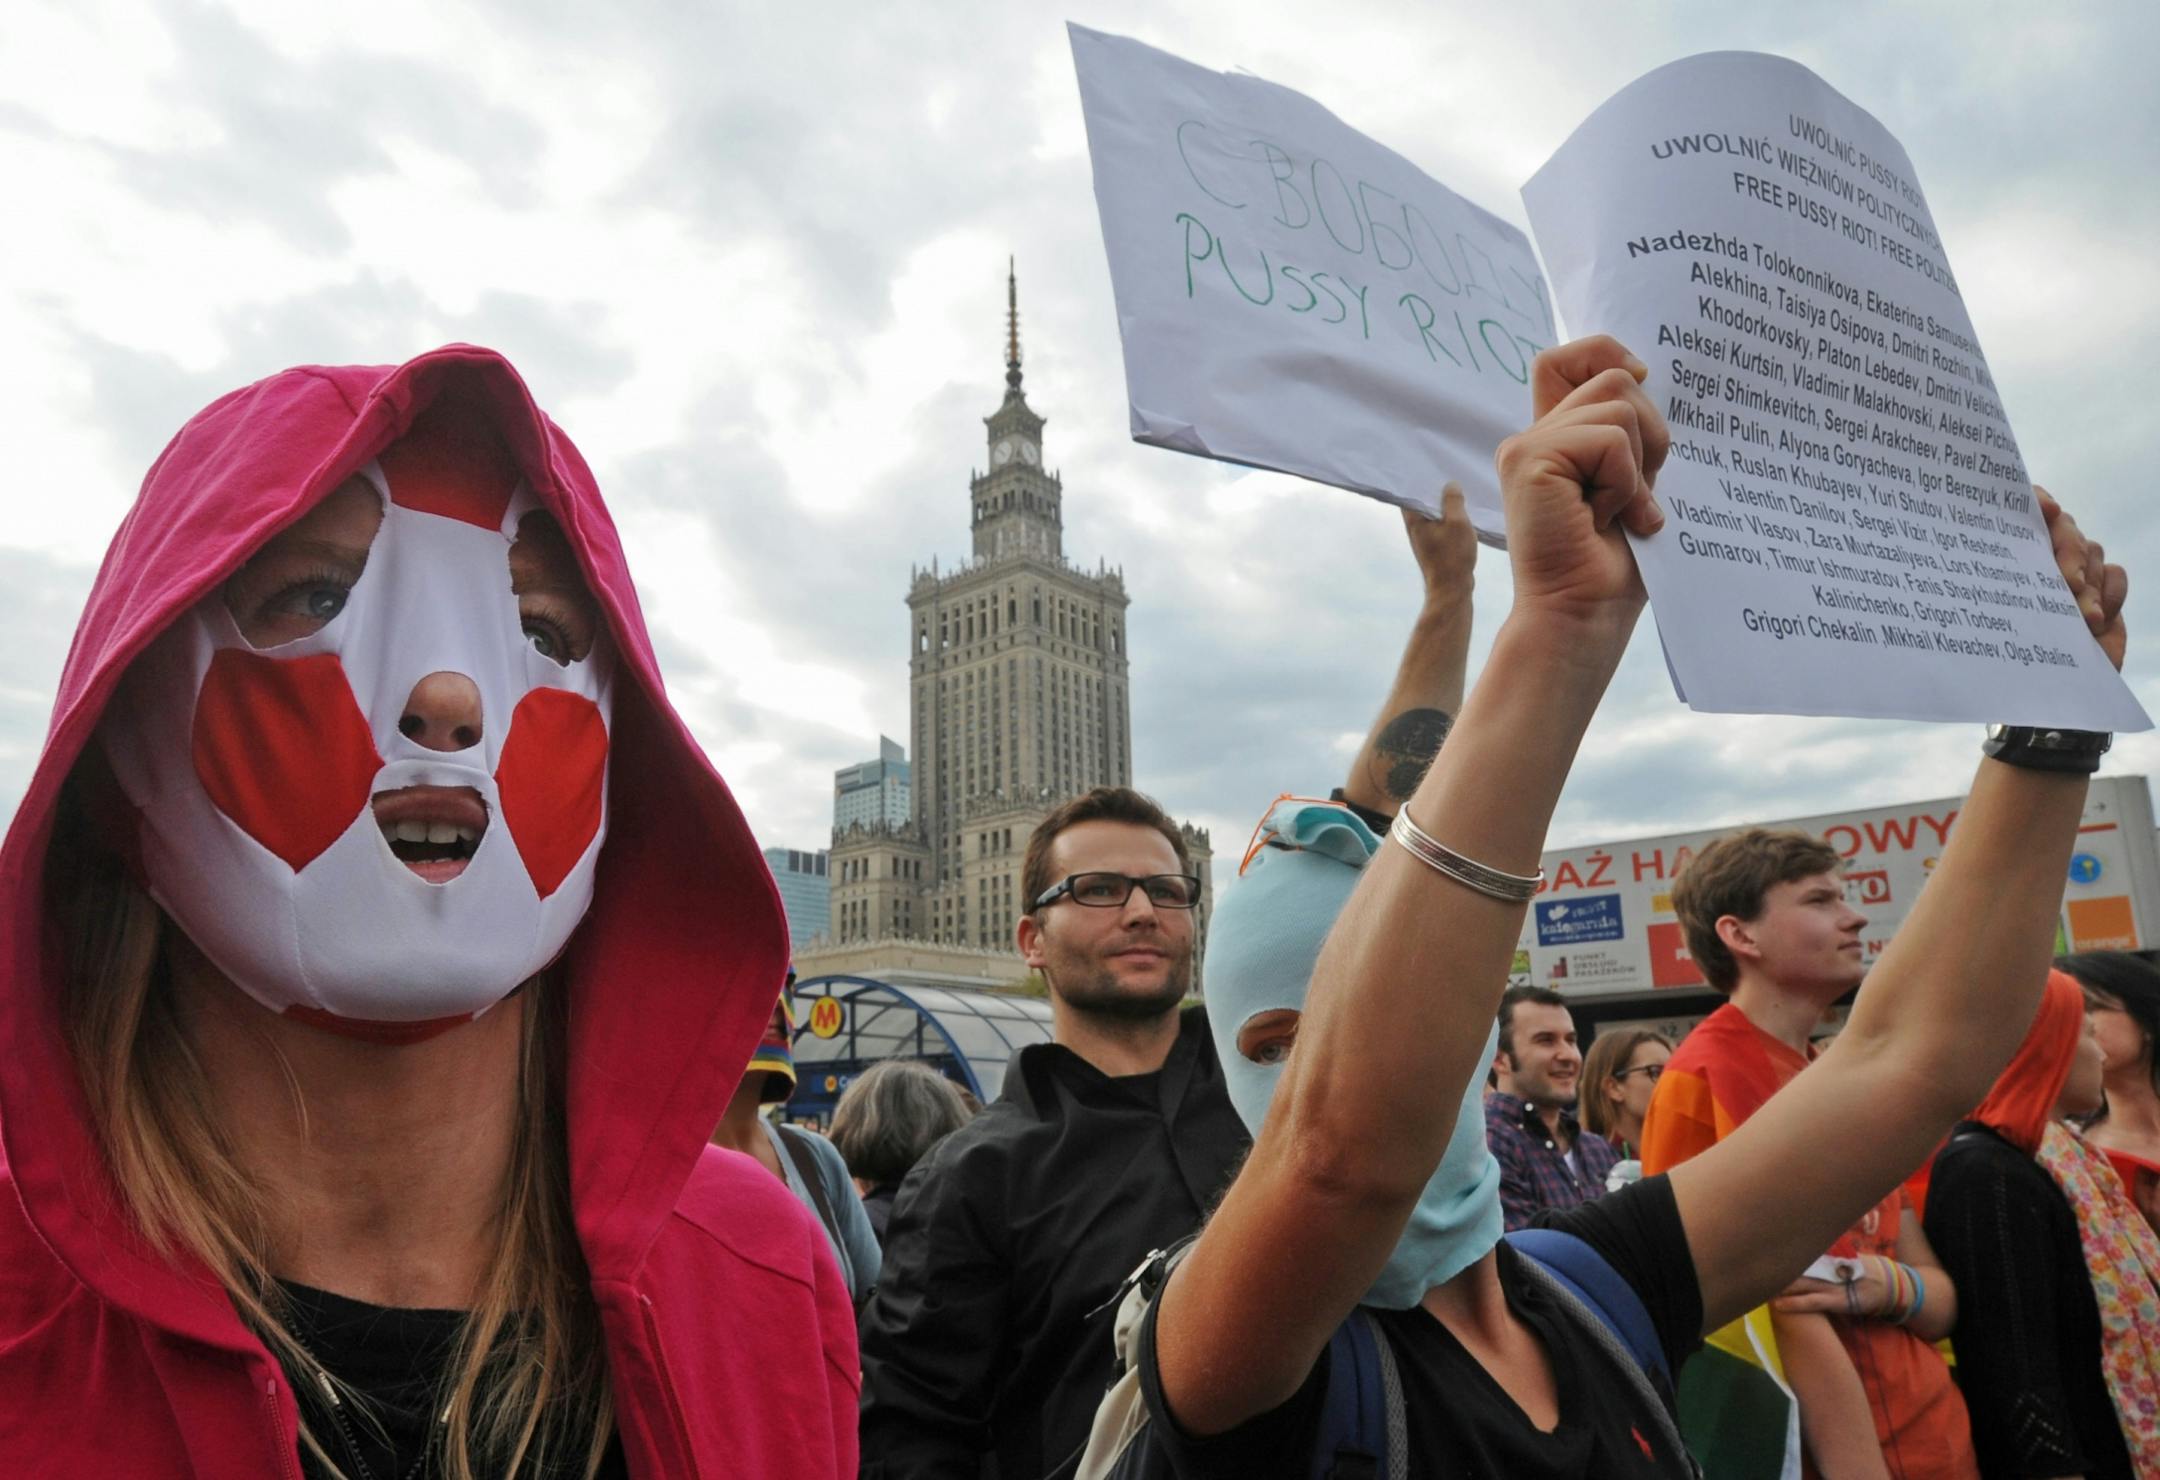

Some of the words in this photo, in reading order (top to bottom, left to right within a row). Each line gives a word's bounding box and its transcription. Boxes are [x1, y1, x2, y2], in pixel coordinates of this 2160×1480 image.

[1651, 133, 1773, 165] UWOLNIĆ
[1789, 113, 1856, 169] UWOLNIĆ
[1859, 152, 1898, 193] PUSSY
[1733, 171, 1783, 209] FREE
[1788, 191, 1838, 231] PUSSY
[1842, 215, 1878, 251] RIOT!
[1881, 235, 1914, 269] FREE
[1176, 212, 1370, 339] PUSSY
[1626, 230, 1749, 262] Nadezhda
[1753, 243, 1862, 311] Tolokonnikova,
[1866, 289, 1924, 332] Ekaterina
[1690, 261, 1772, 309] Alekhina,
[1777, 286, 1826, 328] Taisiya
[1830, 308, 1888, 352] Osipova,
[1892, 332, 1929, 365] Dmitri
[1932, 347, 1974, 385] Rozhin,
[1699, 295, 1813, 361] Khodorkovsky,
[1817, 338, 1861, 372] Platon
[1865, 355, 1923, 396] Lebedev,
[1926, 376, 1962, 407] Dmitri
[1657, 324, 1726, 361] Aleksei
[1730, 341, 1787, 388] Kurtsin,
[1793, 363, 1850, 402] Vladimir
[1853, 384, 1936, 432] Malakhovski,
[1939, 412, 1982, 444] Aleksei
[1671, 359, 1721, 399] Sergei
[1724, 377, 1820, 430] Shimkevitch,
[1824, 408, 1868, 443] Sergei
[1871, 423, 1941, 464] Arakcheev,
[1944, 444, 1976, 471] Pavel
[1667, 397, 1725, 435] Mikhail
[1730, 415, 1774, 449] Pulin,
[1779, 429, 1830, 460] Alyona
[1834, 444, 1916, 487] Goryacheva,
[1918, 467, 1943, 493] Igor
[1945, 475, 2000, 510] Berezyuk,
[2003, 490, 2030, 514] Kirill
[1669, 440, 1728, 473] nchuk,
[1731, 450, 1788, 484] Ruslan
[1791, 464, 1868, 505] Khubayev,
[1869, 483, 1898, 509] Yuri
[1899, 491, 1948, 522] Shutov,
[1948, 503, 1999, 533] Valentin
[1669, 496, 1743, 533] Vladimir
[1806, 527, 1843, 551] Zara
[1843, 534, 1943, 573] Murtazaliyeva,
[1941, 555, 1976, 576] Lors
[1718, 478, 1789, 513] Valentin
[1789, 494, 1853, 530] Danilov,
[1852, 508, 1899, 538] Sergei
[1900, 519, 1935, 545] Vizir,
[1935, 528, 1959, 551] Igor
[1679, 531, 1769, 570] Gumarov,
[1768, 547, 1817, 575] Timur
[1818, 557, 1908, 592] Ishmuratov,
[1905, 572, 1944, 598] Fanis
[1812, 584, 1915, 622] Kalinichenko,
[1914, 601, 1960, 628] Grigori
[1960, 607, 2018, 636] Torbeev,
[1743, 608, 1806, 640] Grigori
[1807, 615, 1878, 644] Chekalin
[1935, 632, 2006, 661] Klevachev,
[2003, 641, 2035, 666] Olga
[815, 1005, 836, 1029] M
